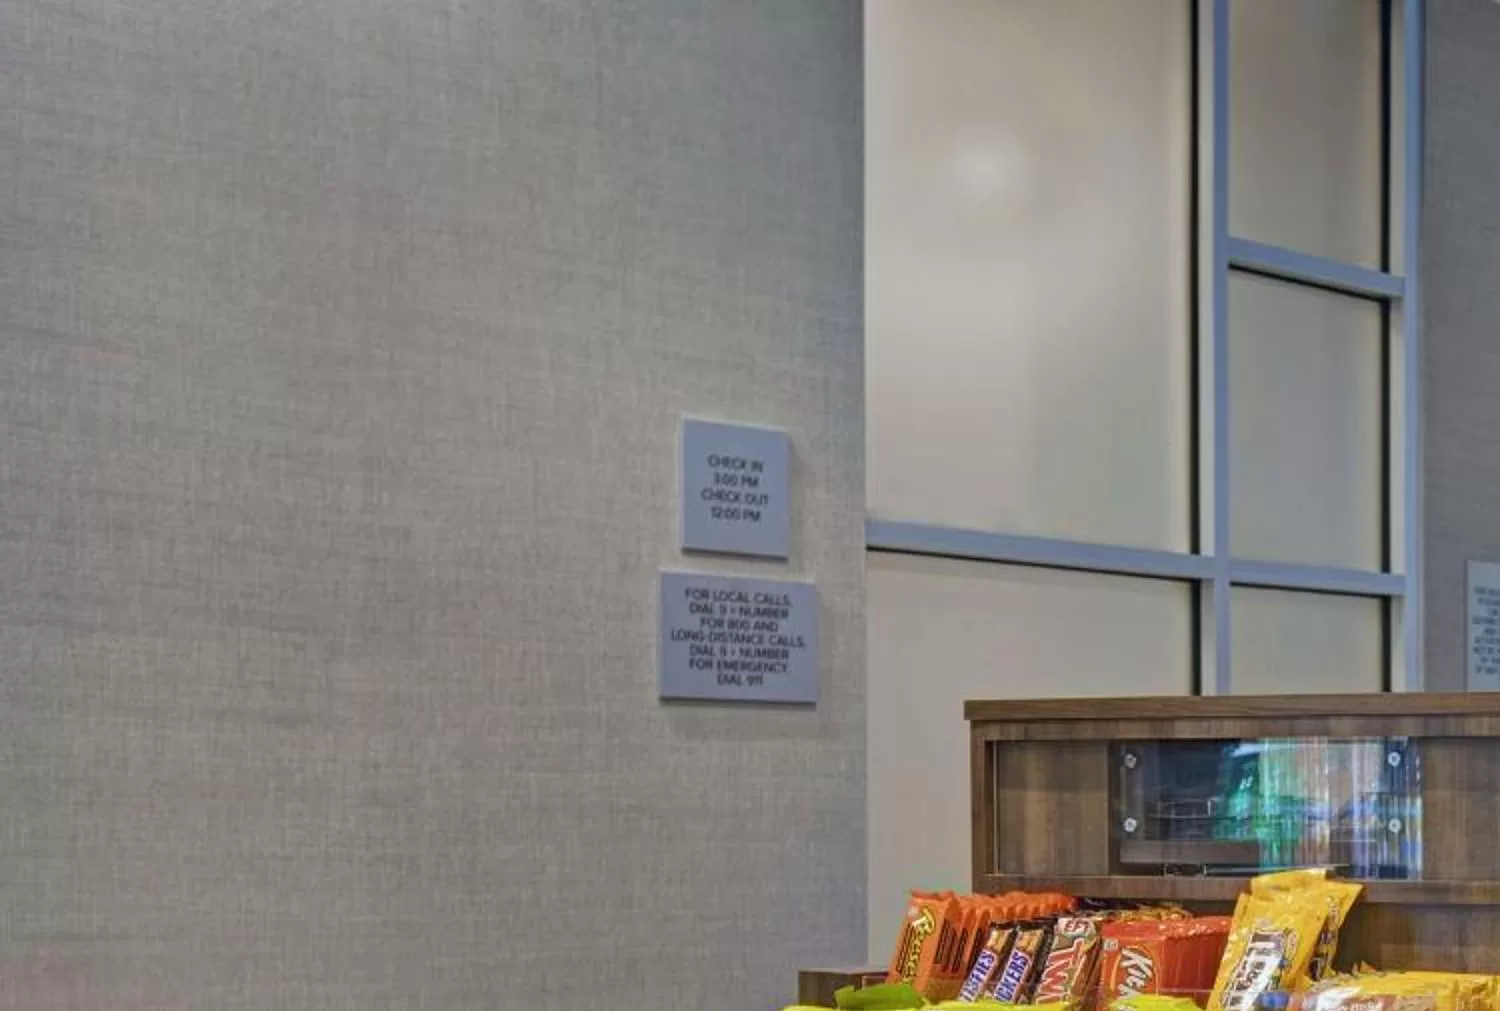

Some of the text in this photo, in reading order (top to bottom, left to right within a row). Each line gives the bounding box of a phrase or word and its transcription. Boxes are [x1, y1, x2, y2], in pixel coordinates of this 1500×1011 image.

[707, 454, 746, 469] CHECK
[741, 474, 759, 488] PM
[700, 488, 768, 505] CHECK OUT
[743, 508, 761, 522] PM
[684, 588, 710, 600] FOR
[713, 590, 749, 603] LOCAL
[689, 602, 713, 614] DIAL
[739, 606, 789, 619] NUMBER
[700, 618, 725, 629] FOR
[754, 621, 779, 632] AND
[671, 628, 705, 642] LONG
[709, 631, 765, 644] DISTANCE
[689, 644, 714, 657] DIAL
[739, 647, 789, 660] NUMBER
[688, 657, 714, 670] FOR
[717, 674, 742, 686] DIAL
